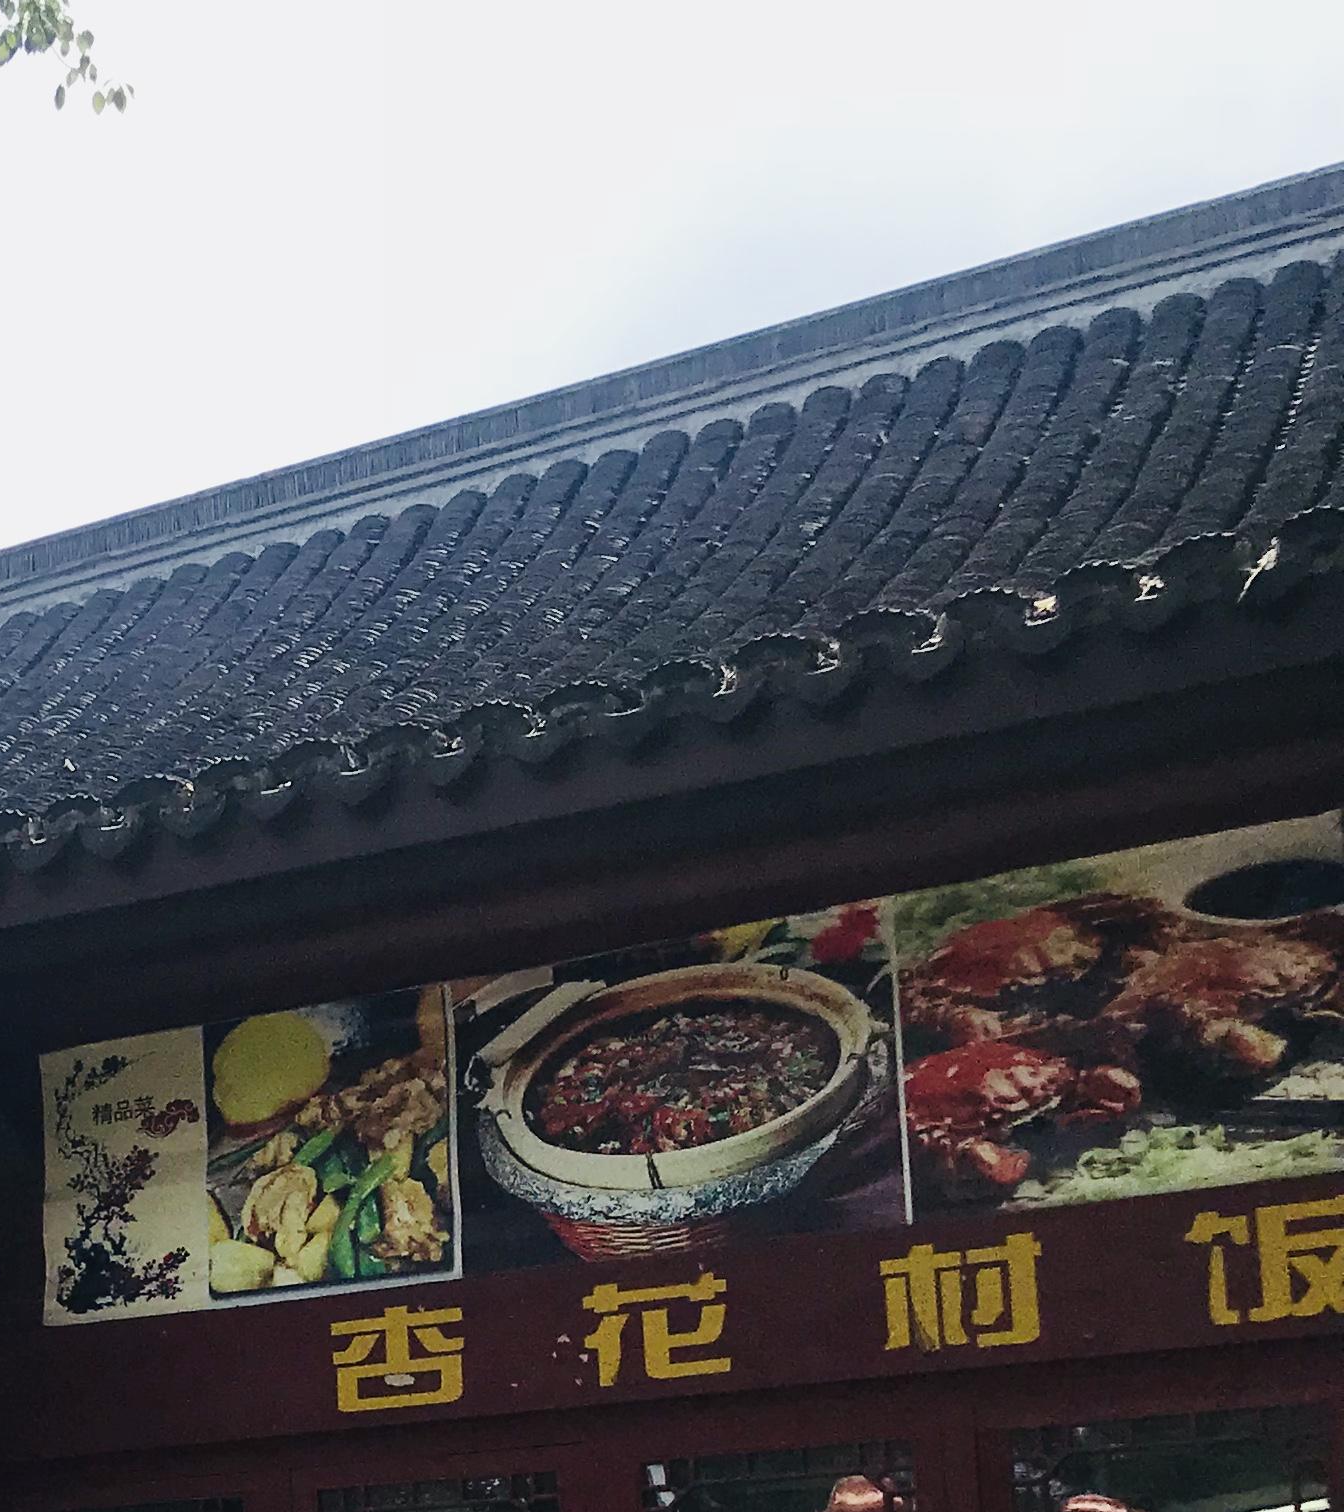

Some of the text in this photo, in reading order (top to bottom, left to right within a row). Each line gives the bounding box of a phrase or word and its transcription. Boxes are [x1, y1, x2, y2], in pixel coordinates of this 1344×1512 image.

[91, 1095, 155, 1125] 精品菜
[328, 1193, 1344, 1413] 杏花村饭
